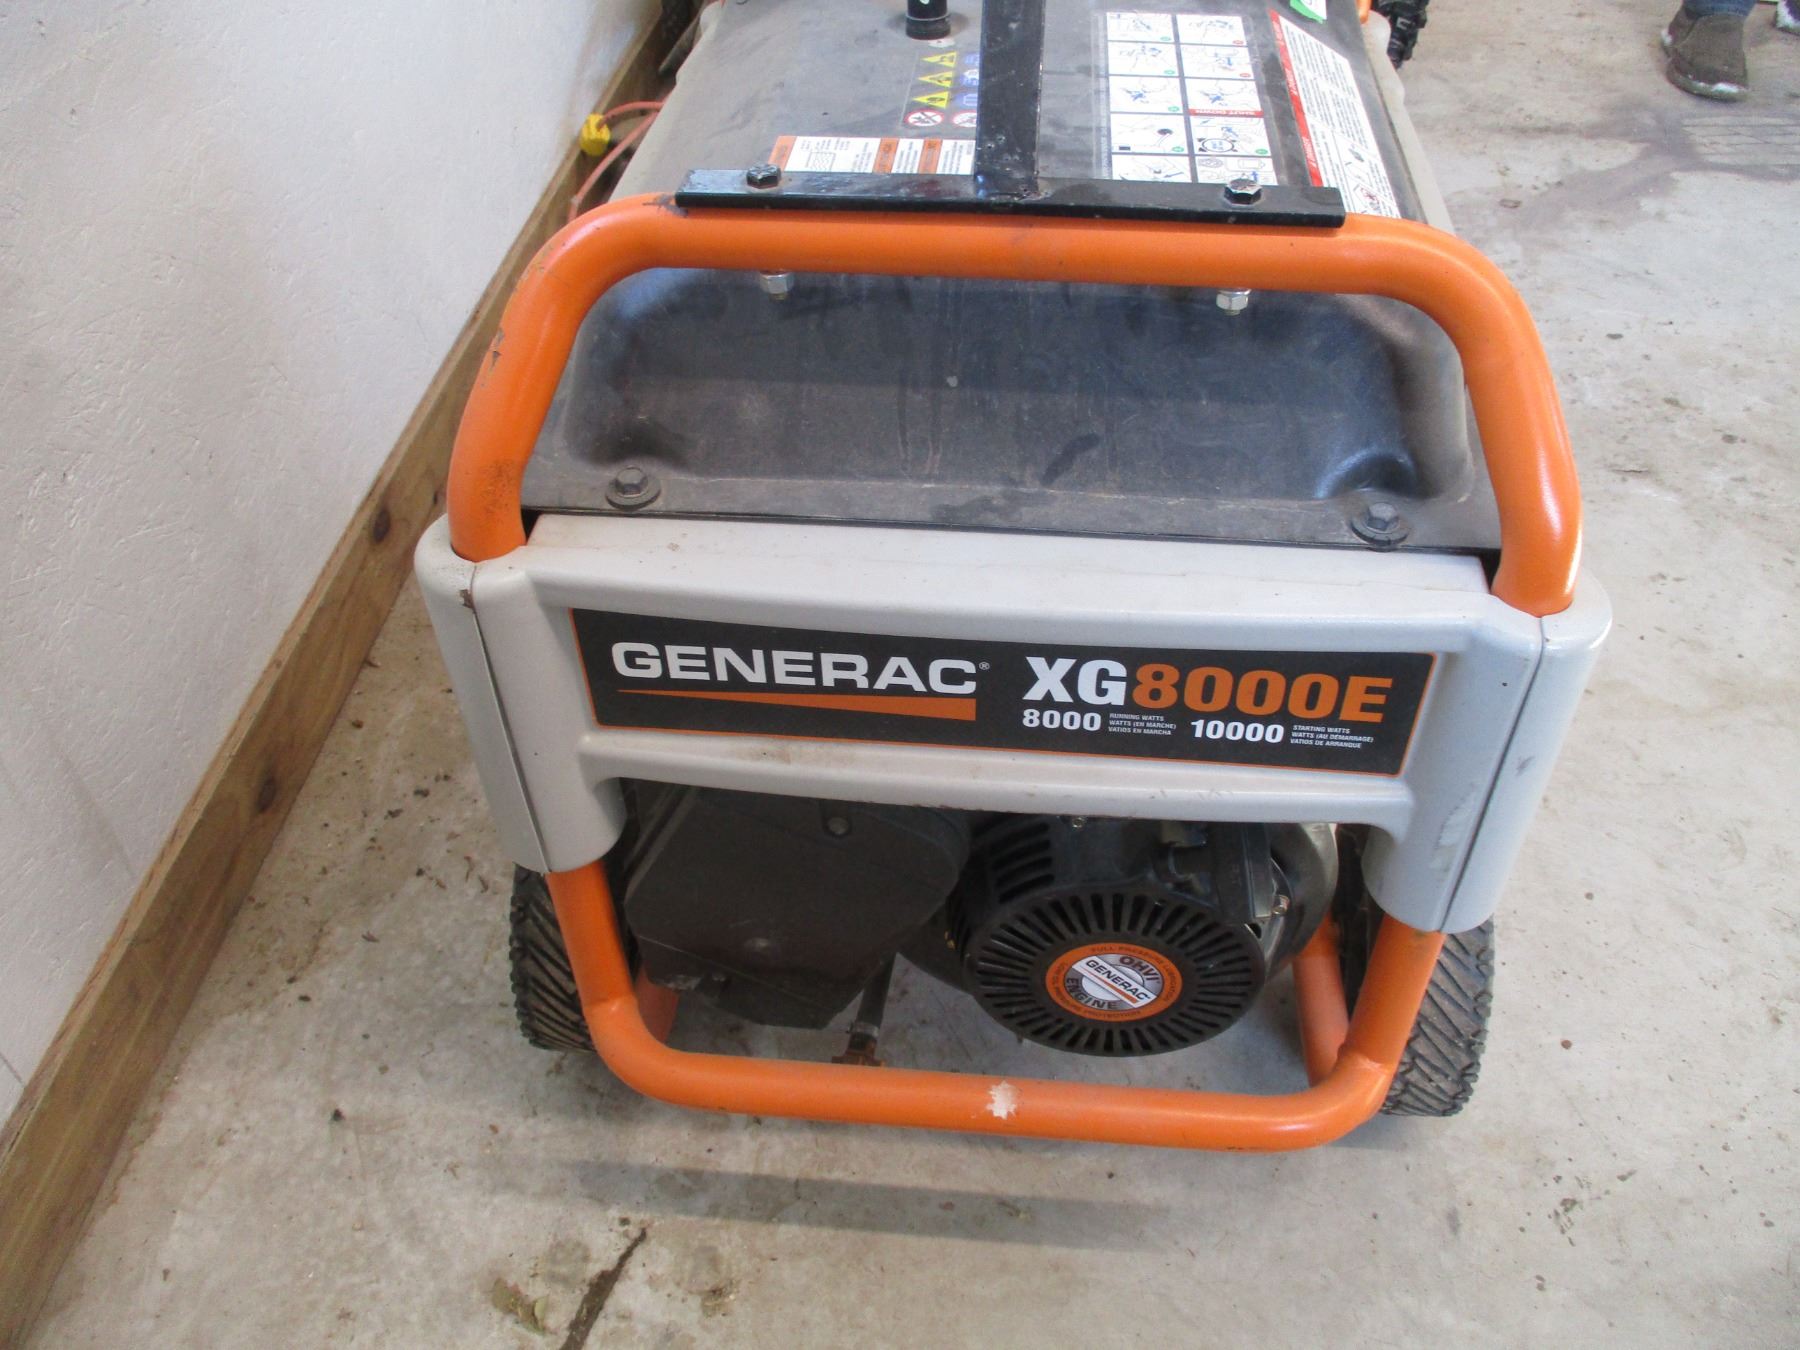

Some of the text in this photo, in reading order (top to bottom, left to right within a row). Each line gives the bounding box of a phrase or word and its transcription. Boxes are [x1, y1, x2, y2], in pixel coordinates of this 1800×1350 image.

[1022, 656, 1393, 722] XG8000E
[1022, 709, 1102, 732] 8000
[1190, 718, 1285, 744] 10000
[1292, 724, 1326, 732] STARTING
[1066, 977, 1118, 1009] ENGINE
